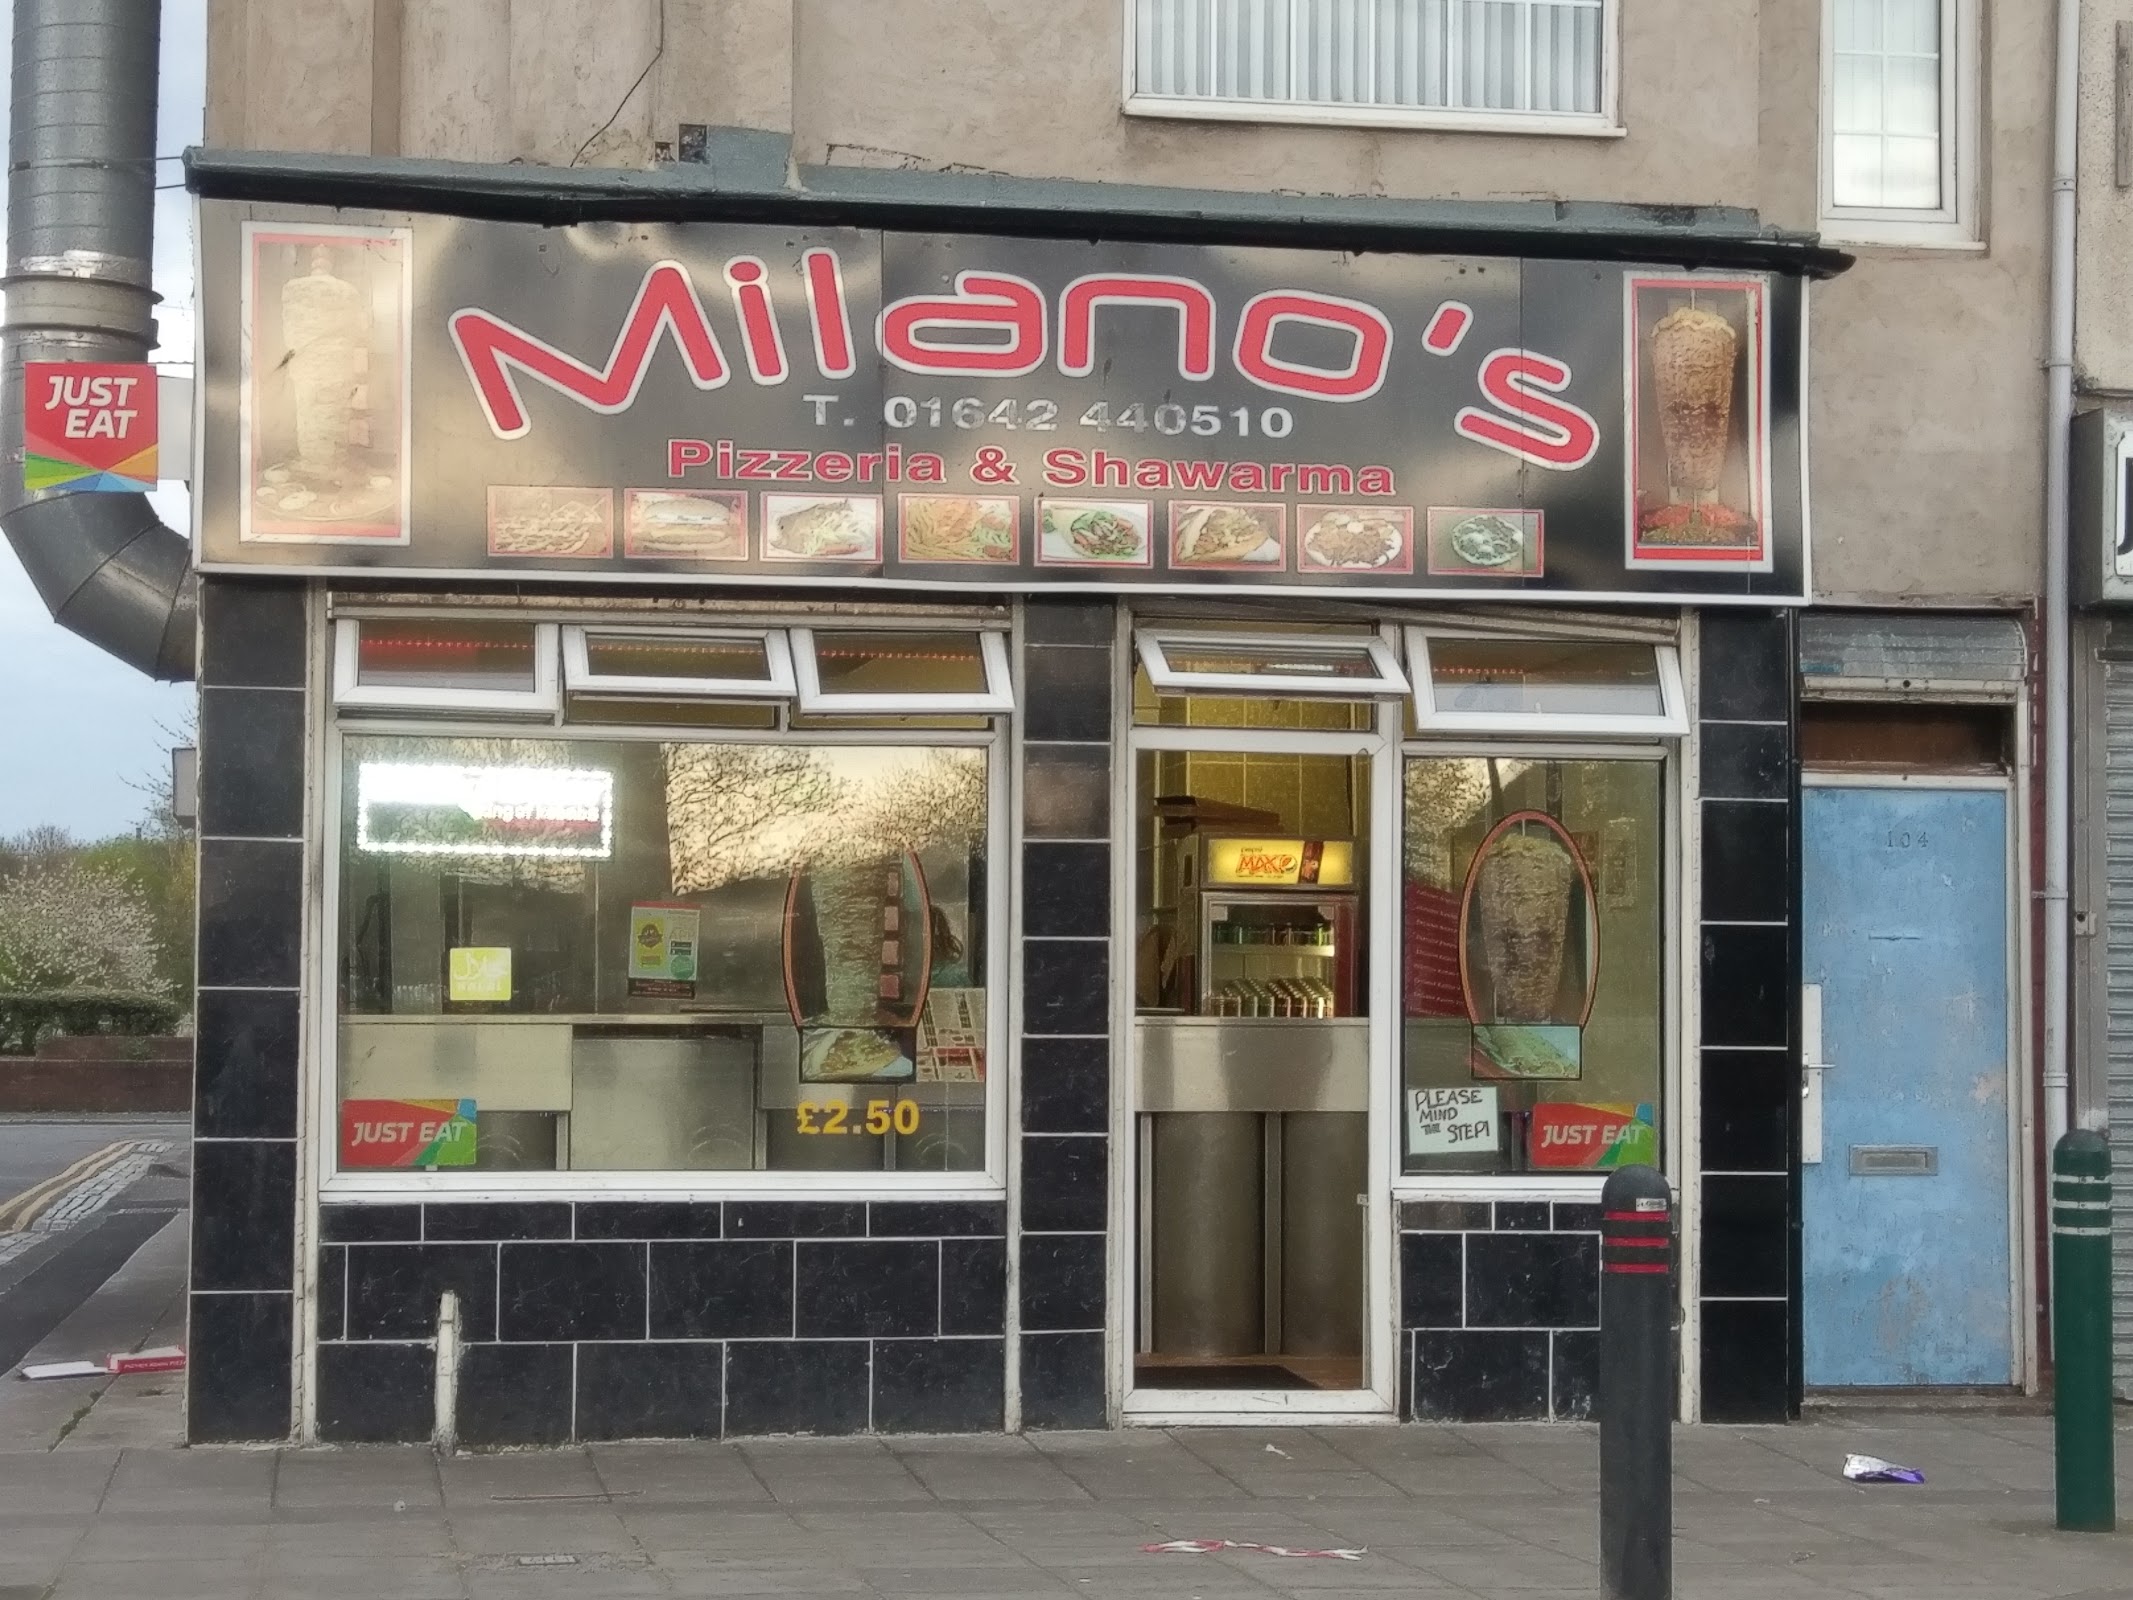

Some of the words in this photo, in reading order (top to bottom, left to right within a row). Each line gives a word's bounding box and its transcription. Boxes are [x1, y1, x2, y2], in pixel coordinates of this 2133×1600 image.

[447, 246, 1601, 473] Milano's
[45, 375, 138, 411] JUST
[64, 409, 139, 439] EAT
[803, 394, 854, 429] T.
[885, 396, 1058, 432] 01642
[1079, 399, 1294, 439] 440510
[667, 438, 946, 484] Pizzeria
[970, 446, 1019, 487] &
[1045, 447, 1396, 496] Shawarma
[1887, 830, 1929, 848] 104
[1415, 1089, 1483, 1111] PLEASE
[796, 1099, 921, 1135] £2.50
[1419, 1107, 1458, 1124] MIND
[351, 1120, 412, 1147] JUST
[418, 1120, 469, 1144] EAT
[1541, 1125, 1597, 1148] JUST
[1601, 1125, 1641, 1145] EAT
